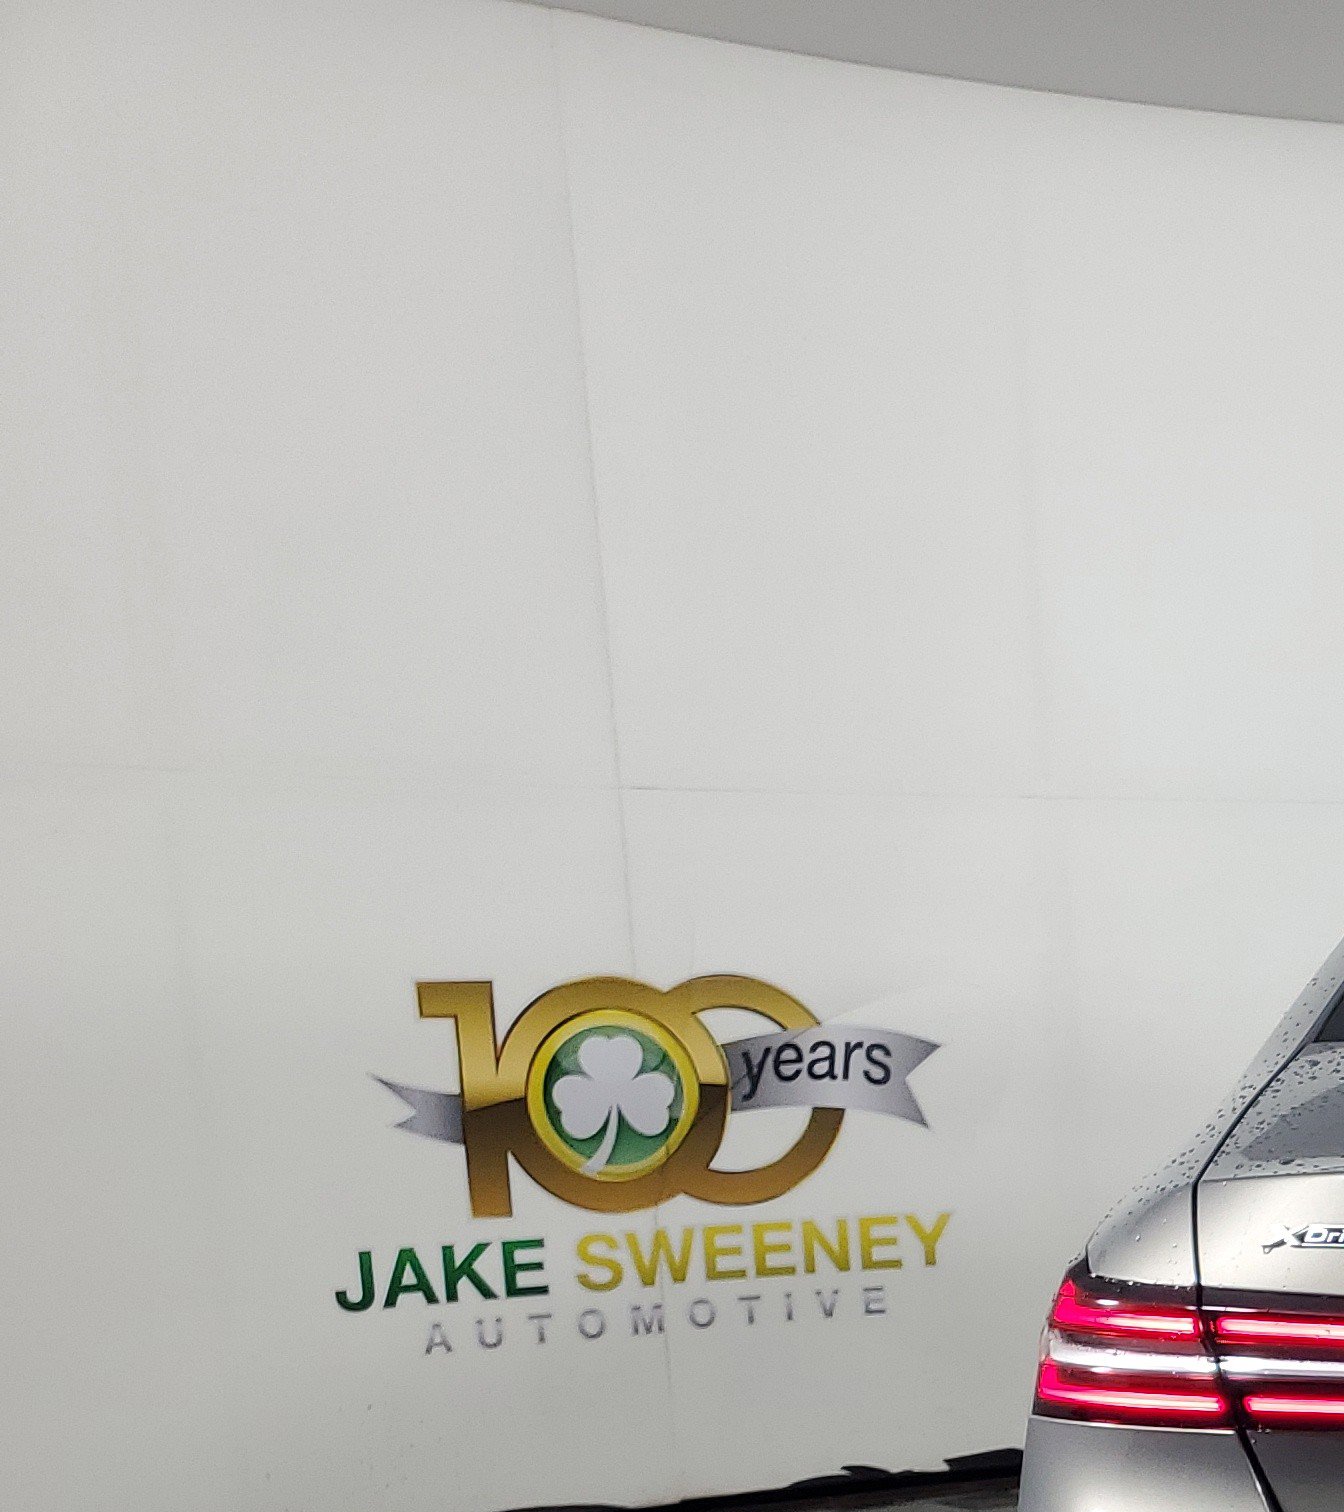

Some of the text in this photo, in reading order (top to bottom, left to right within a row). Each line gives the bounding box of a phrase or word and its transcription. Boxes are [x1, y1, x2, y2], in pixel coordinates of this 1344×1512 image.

[415, 974, 893, 1218] 100 years
[334, 1212, 954, 1312] JAKE SWEENEY
[424, 1285, 888, 1356] AUTOMOTIVE
